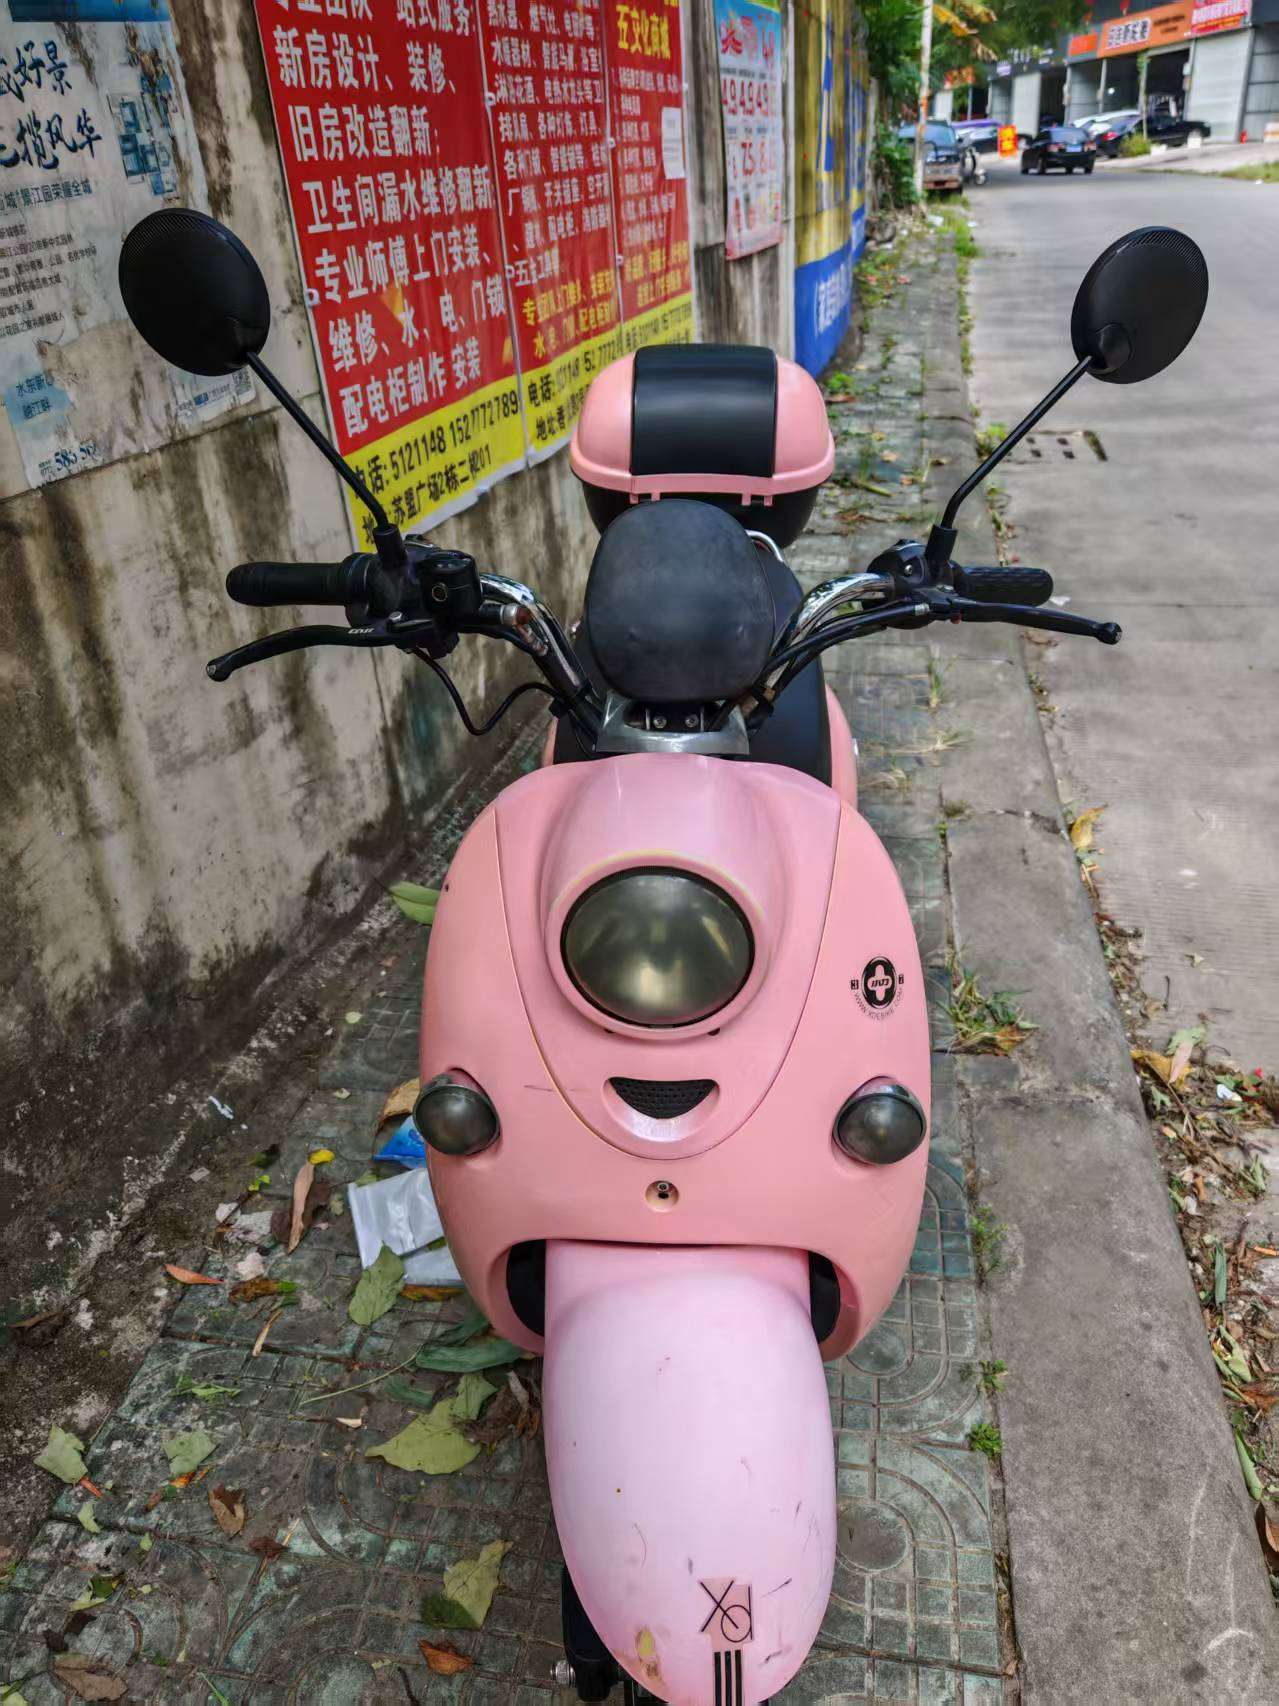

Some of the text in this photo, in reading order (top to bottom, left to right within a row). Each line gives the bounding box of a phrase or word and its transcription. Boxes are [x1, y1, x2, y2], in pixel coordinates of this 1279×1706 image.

[273, 24, 456, 94] 新房设计、 装修、
[301, 163, 492, 234] 卫生间漏水维修翻新
[315, 224, 491, 304] 专业师傅上门安装、
[328, 309, 390, 373] 维修、
[451, 336, 482, 390] 安装
